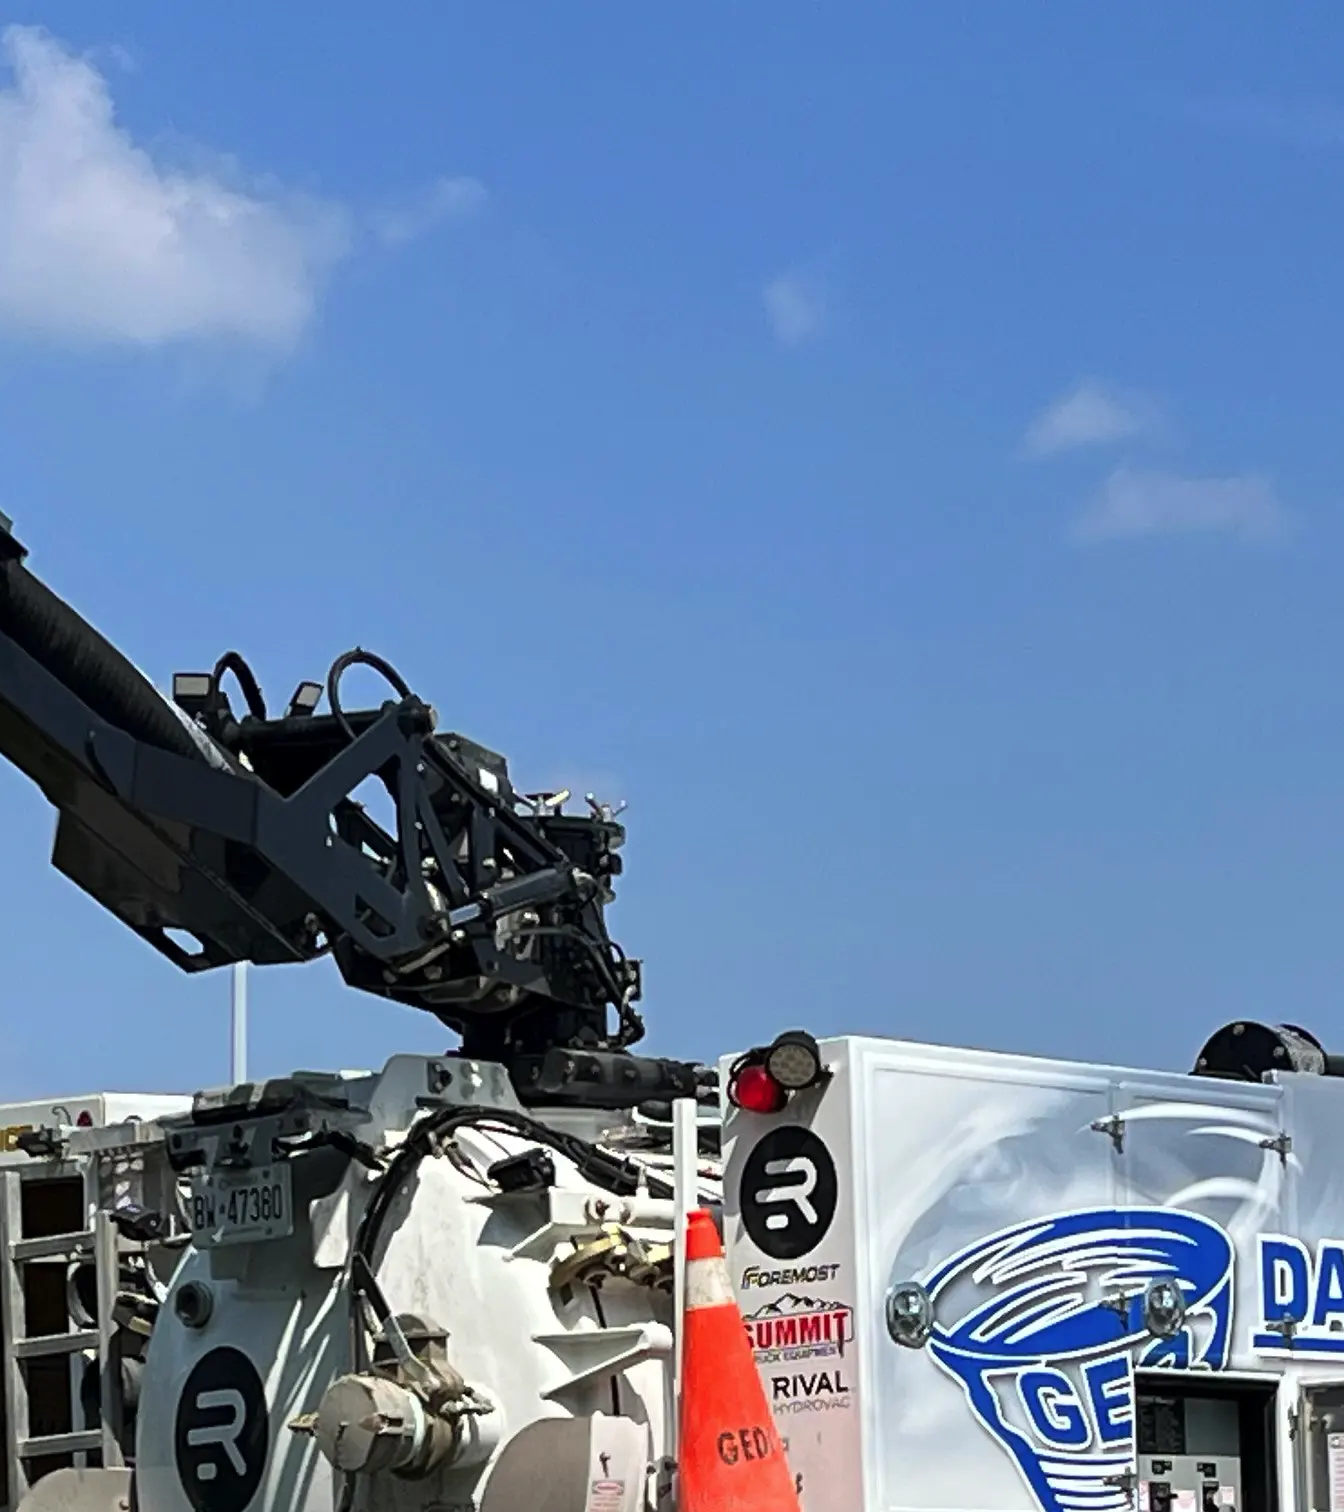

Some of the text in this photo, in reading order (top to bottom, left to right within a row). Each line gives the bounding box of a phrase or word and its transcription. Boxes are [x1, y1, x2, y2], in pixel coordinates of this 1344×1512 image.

[741, 1264, 840, 1289] FOREMOST
[772, 1371, 848, 1400] RIVAL
[773, 1396, 850, 1415] HYDROVAC
